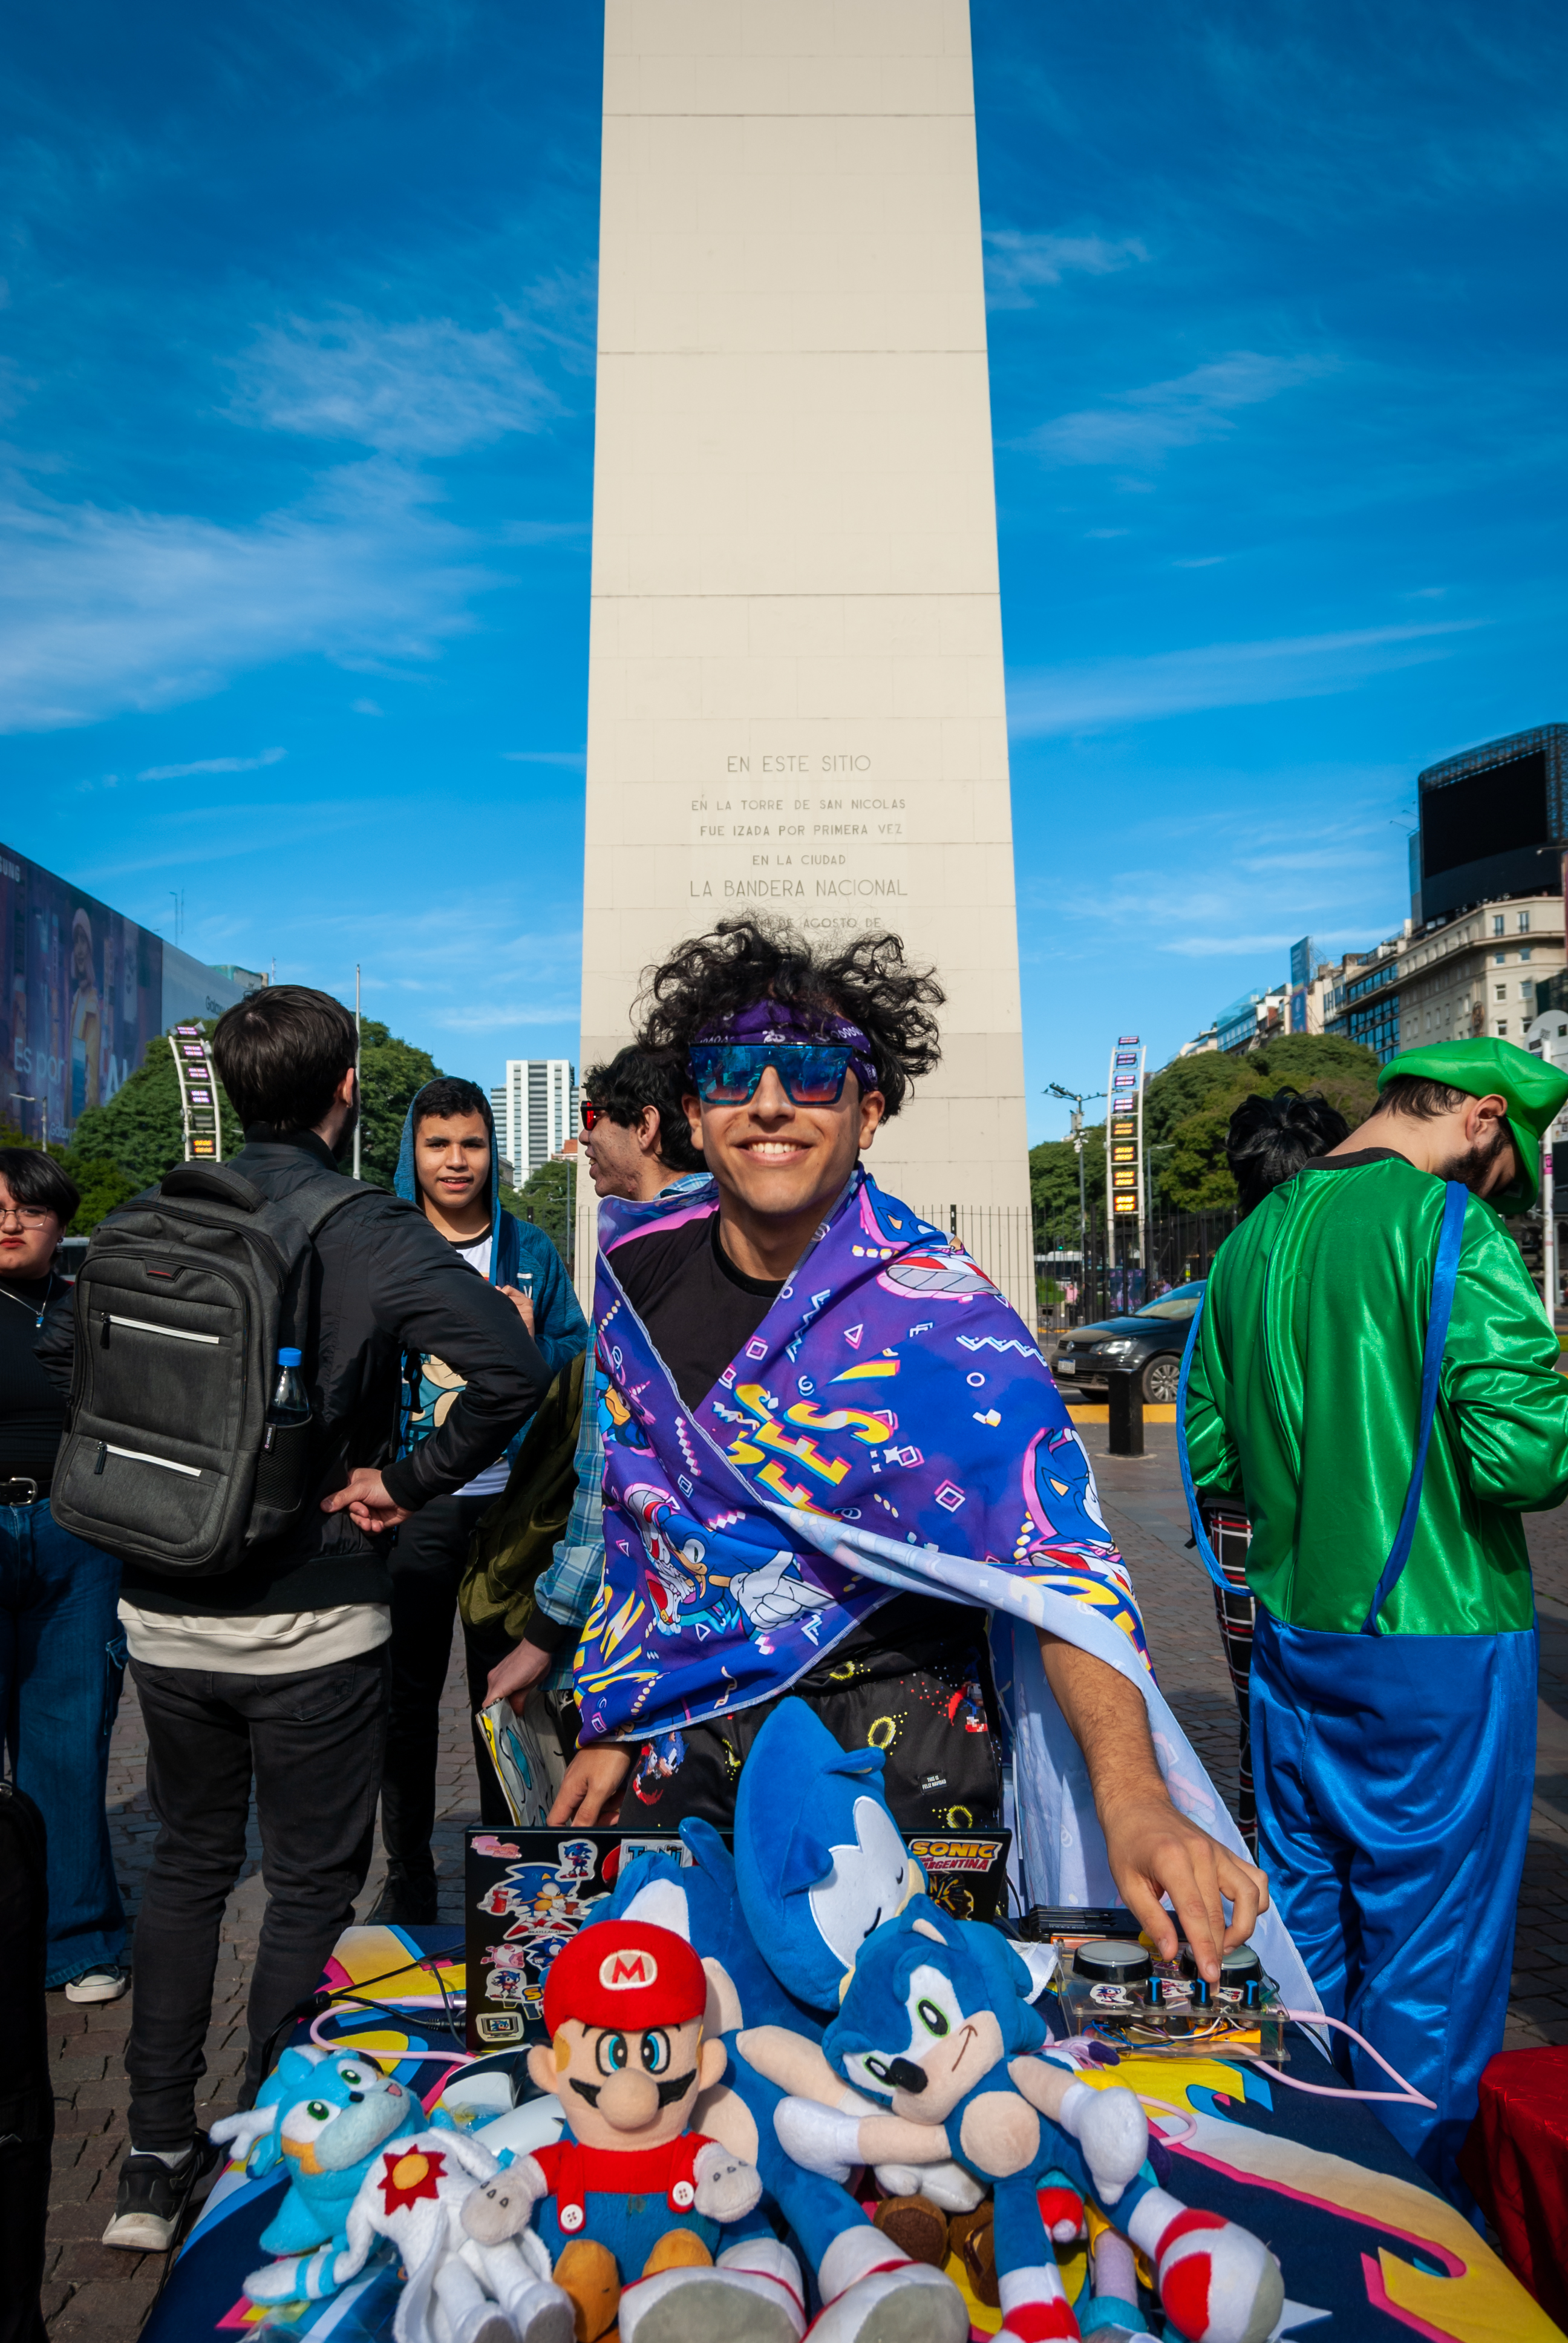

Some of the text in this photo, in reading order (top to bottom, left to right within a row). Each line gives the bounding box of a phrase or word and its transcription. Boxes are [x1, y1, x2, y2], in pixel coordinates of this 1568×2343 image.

[727, 755, 871, 772] EN ESTE SITIO
[691, 799, 906, 811] EN LA TORRE DE SAN NICOLAS
[700, 824, 903, 836] FUE IZADA POR PRIMERA VEZ
[752, 854, 846, 865] EN LA CIUDAD
[690, 879, 908, 897] LA BANDERA NACIONAL
[803, 917, 857, 928] AGOSTO
[866, 917, 881, 928] DE
[14, 1037, 32, 1075] Es
[36, 1050, 65, 1089] por
[912, 1841, 997, 1858] SONIC
[611, 1954, 646, 1984] M
